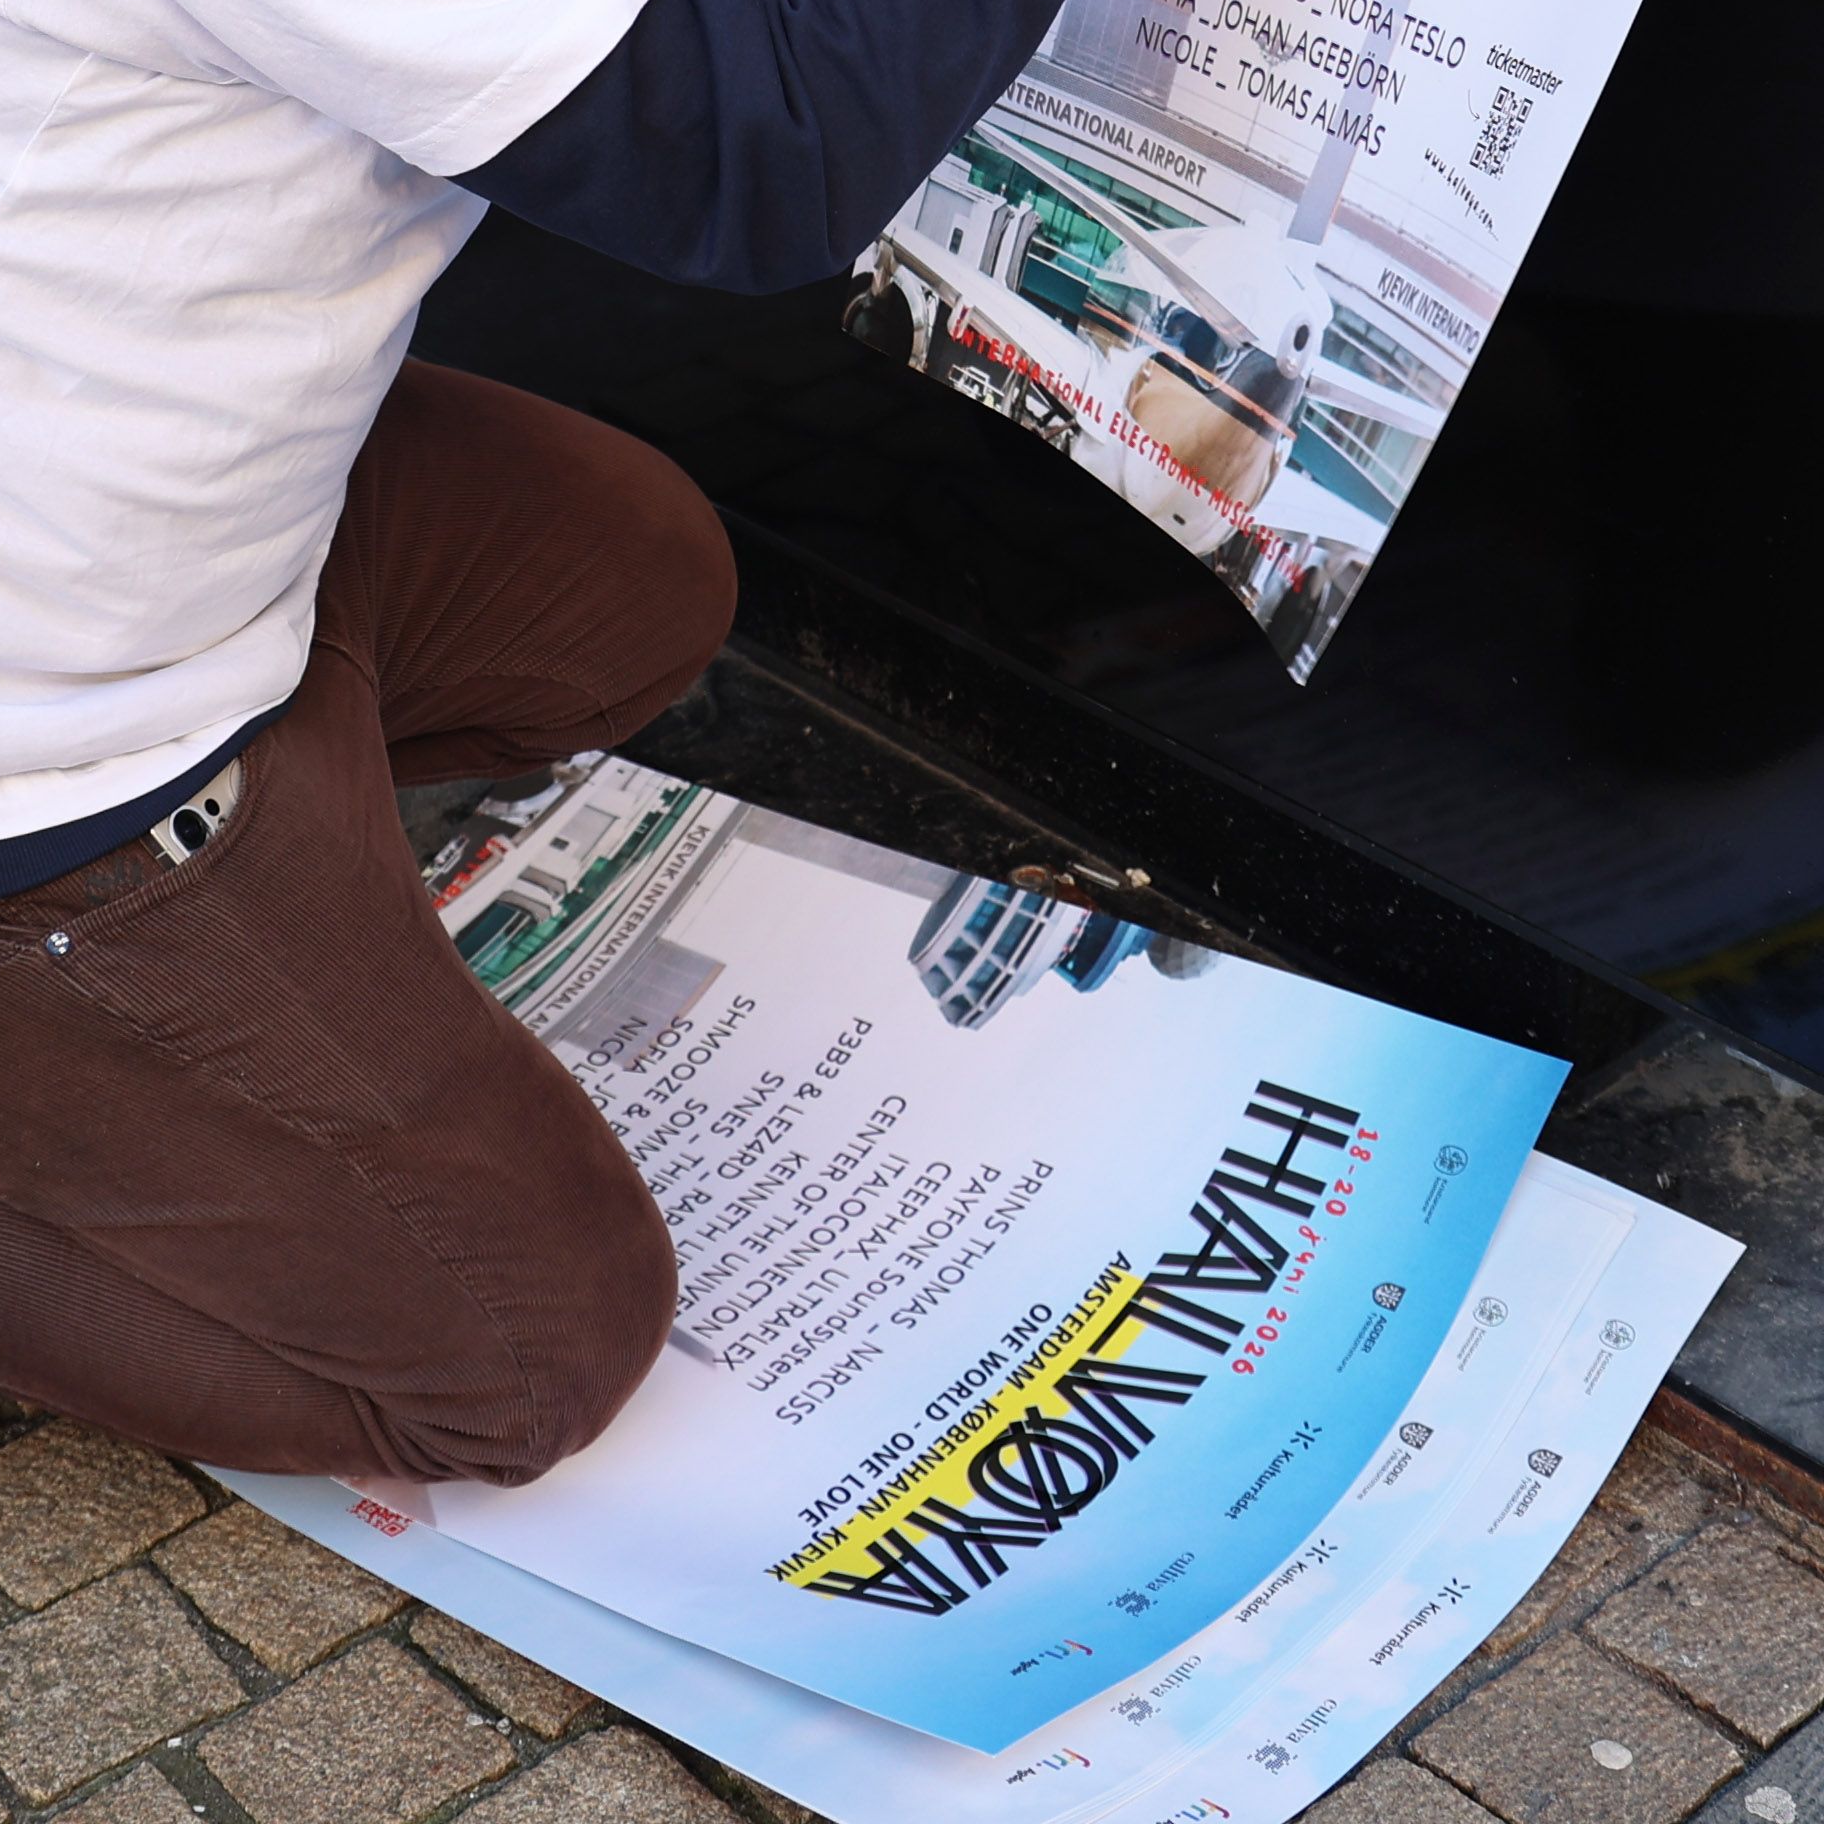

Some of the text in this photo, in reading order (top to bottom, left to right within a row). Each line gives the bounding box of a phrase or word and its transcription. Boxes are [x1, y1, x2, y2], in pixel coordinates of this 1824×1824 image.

[1288, 30, 1404, 104] AGEBJÖRN
[1401, 13, 1466, 69] TESLO
[1486, 44, 1563, 95] ticketmaster
[1135, 16, 1218, 77] NICOLE
[1237, 59, 1313, 120] TOMAS
[1310, 98, 1386, 157] ALMÅS
[1136, 137, 1207, 187] AIRPORT
[1377, 267, 1420, 311] KJEVIK
[545, 824, 711, 1010] KJEVIK INTERNATIONAL
[622, 1012, 694, 1074] SOFIA
[643, 995, 756, 1105] SHMOOZE
[814, 1017, 873, 1080] P3B3
[622, 1103, 651, 1119] &
[710, 1071, 785, 1138] SYNES
[793, 1082, 823, 1100] &
[666, 1095, 907, 1320] CENTER OF THE UNIVE
[695, 1151, 809, 1243] KENNETH
[984, 1159, 1054, 1235] PRINS
[690, 1154, 909, 1340] ITALOCONNECTION
[747, 1164, 1002, 1392] PAYFONE Soundsystem
[1231, 1127, 1379, 1375] 18-20 juni 2026
[890, 1238, 996, 1330] THOMAS
[708, 1268, 849, 1372] ULTRAFLEX
[801, 1080, 1361, 1619] HALVØYA
[1000, 1303, 1053, 1353] ONE
[1005, 1250, 1132, 1391] AMSTERDAM
[1361, 1314, 1388, 1354] AGDER
[775, 1341, 884, 1426] NARCISS
[925, 1350, 1009, 1422] WORLD
[856, 1398, 1000, 1521] KØBENHAVN
[859, 1432, 915, 1479] ONE
[1224, 1449, 1294, 1520] Kulturrådet
[1383, 1451, 1412, 1486] AGDER
[798, 1473, 863, 1528] LOVE
[1513, 1480, 1542, 1518] AGDER
[764, 1526, 849, 1583] KJEVIK
[1145, 1552, 1195, 1592] cultiva
[1235, 1560, 1308, 1623] Kulturrådet
[1369, 1601, 1441, 1666] Kulturrådet
[1149, 1655, 1202, 1698] cultiva
[1285, 1699, 1337, 1744] cultiva
